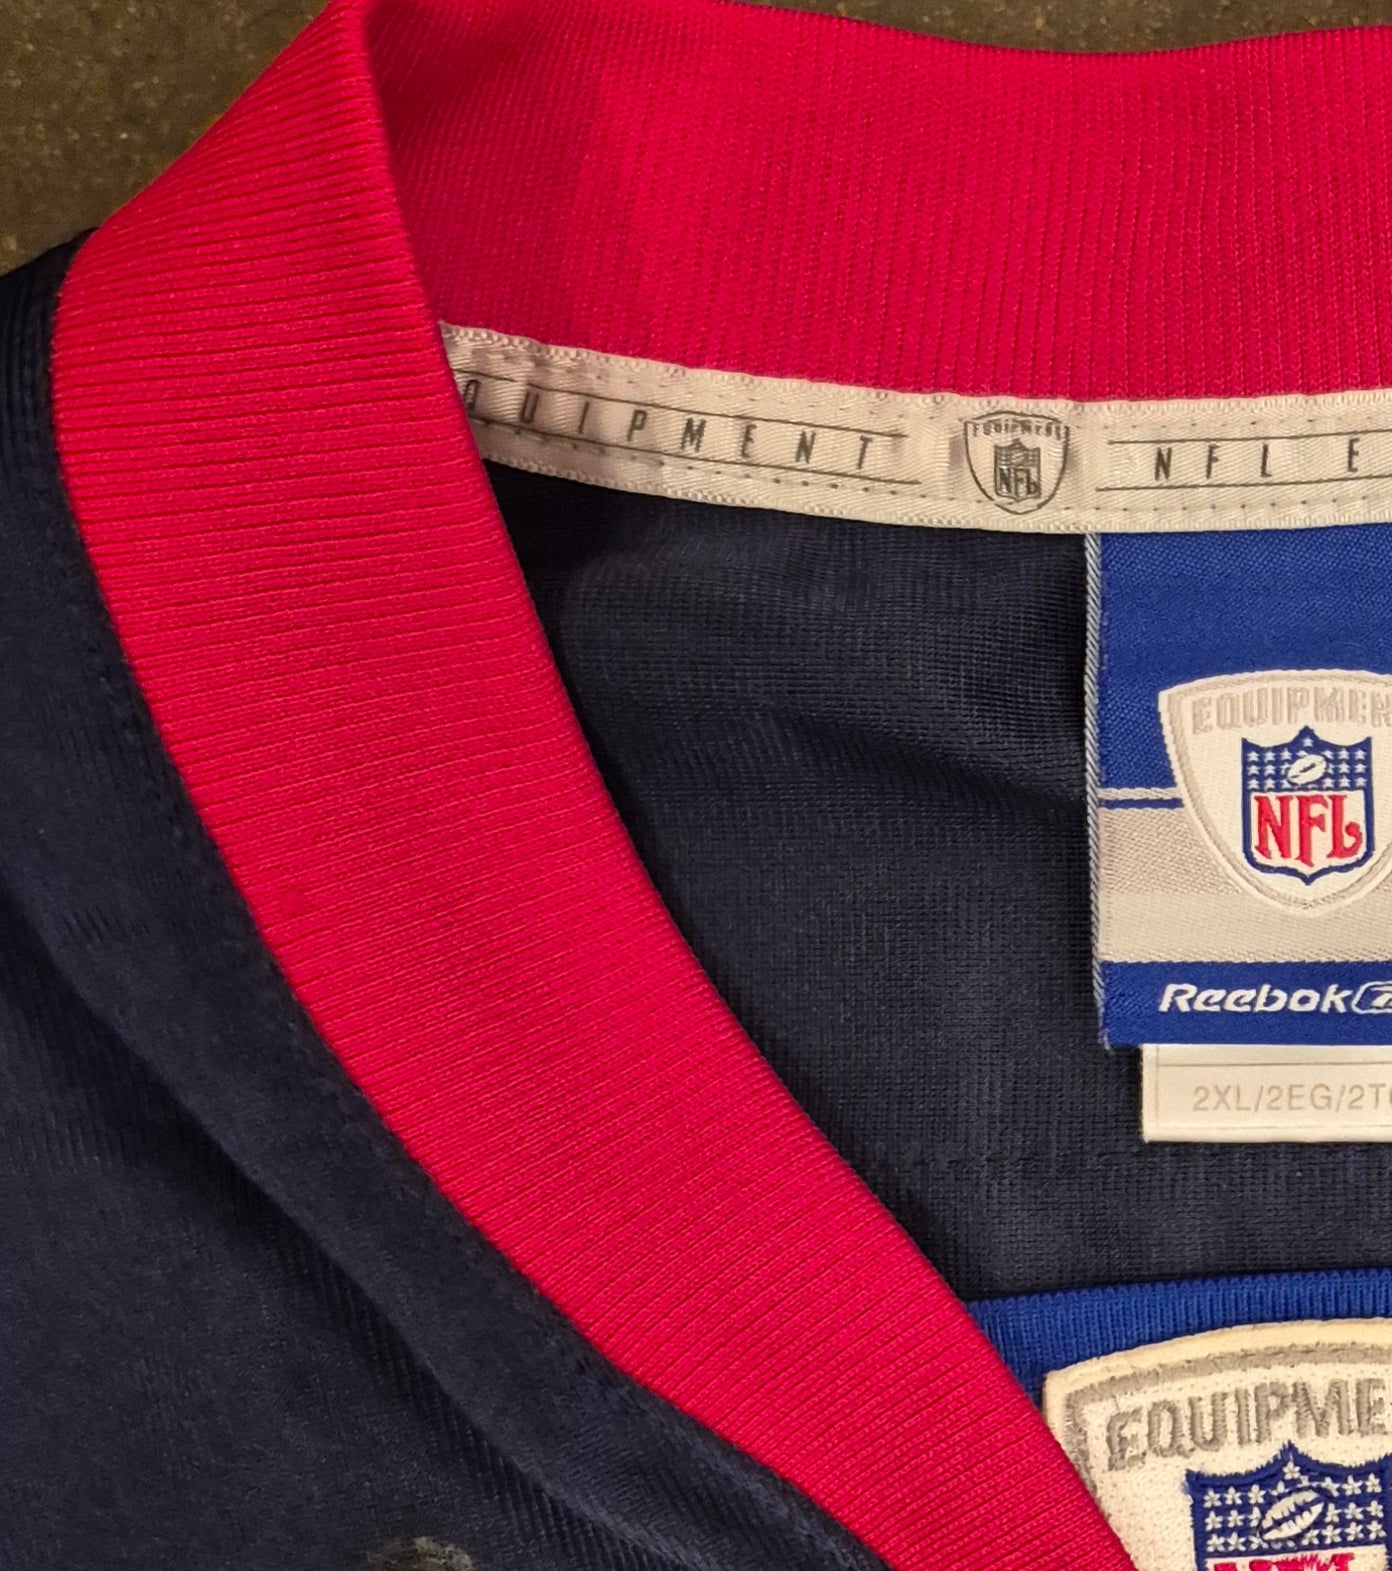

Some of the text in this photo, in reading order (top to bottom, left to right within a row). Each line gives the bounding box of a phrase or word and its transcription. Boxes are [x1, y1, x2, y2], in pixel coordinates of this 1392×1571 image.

[463, 379, 874, 471] QUIPMENT
[1155, 444, 1271, 482] NFL
[1254, 794, 1364, 867] NFL
[1158, 983, 1354, 1013] Reebok
